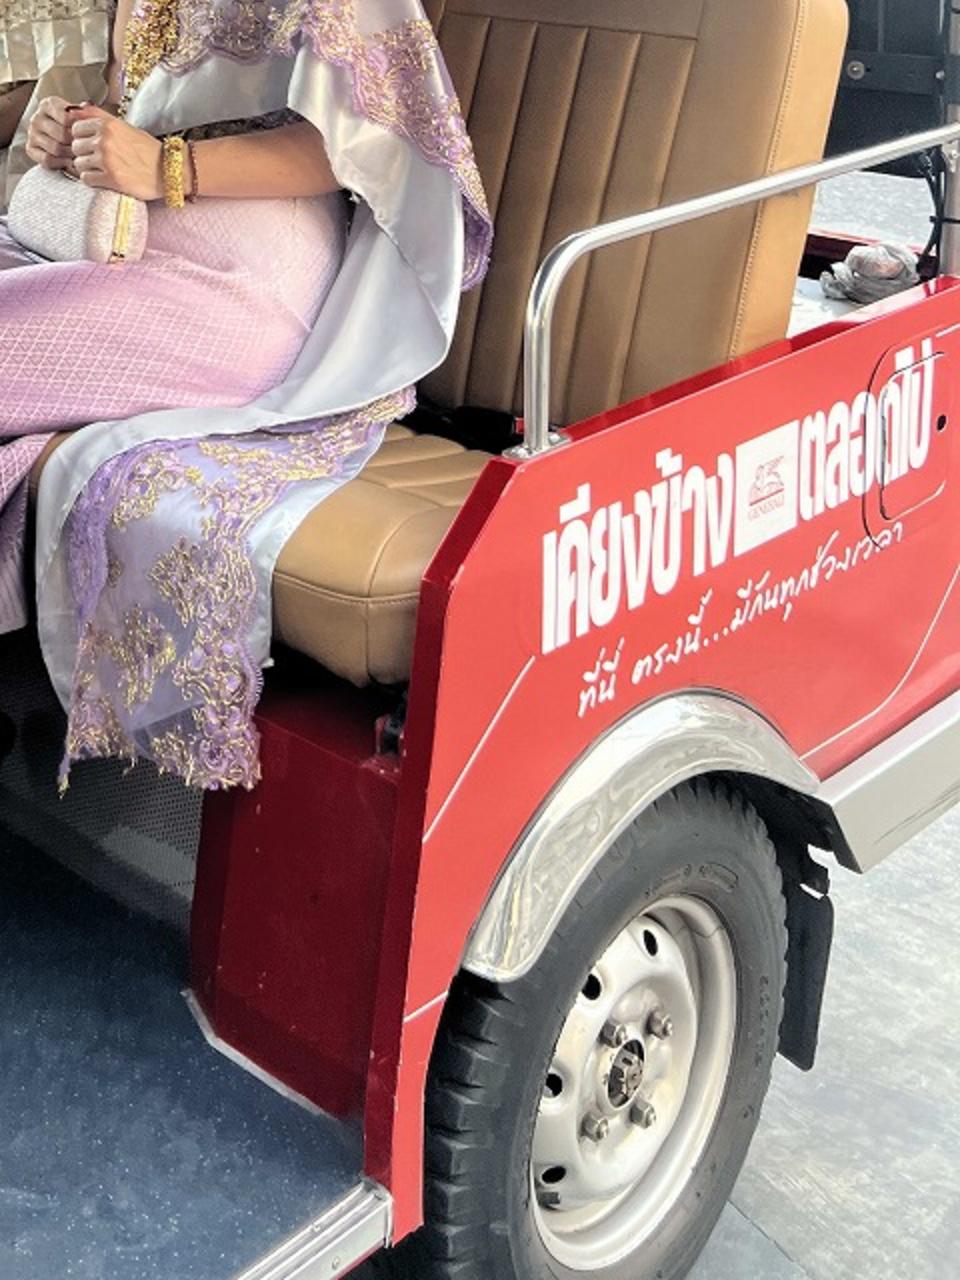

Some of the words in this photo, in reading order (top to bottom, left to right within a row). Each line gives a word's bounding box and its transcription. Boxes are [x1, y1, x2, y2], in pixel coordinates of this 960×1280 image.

[801, 338, 934, 521] ตลอดไป
[542, 447, 735, 655] เคียงข้าง
[577, 637, 625, 718] ที่นี่
